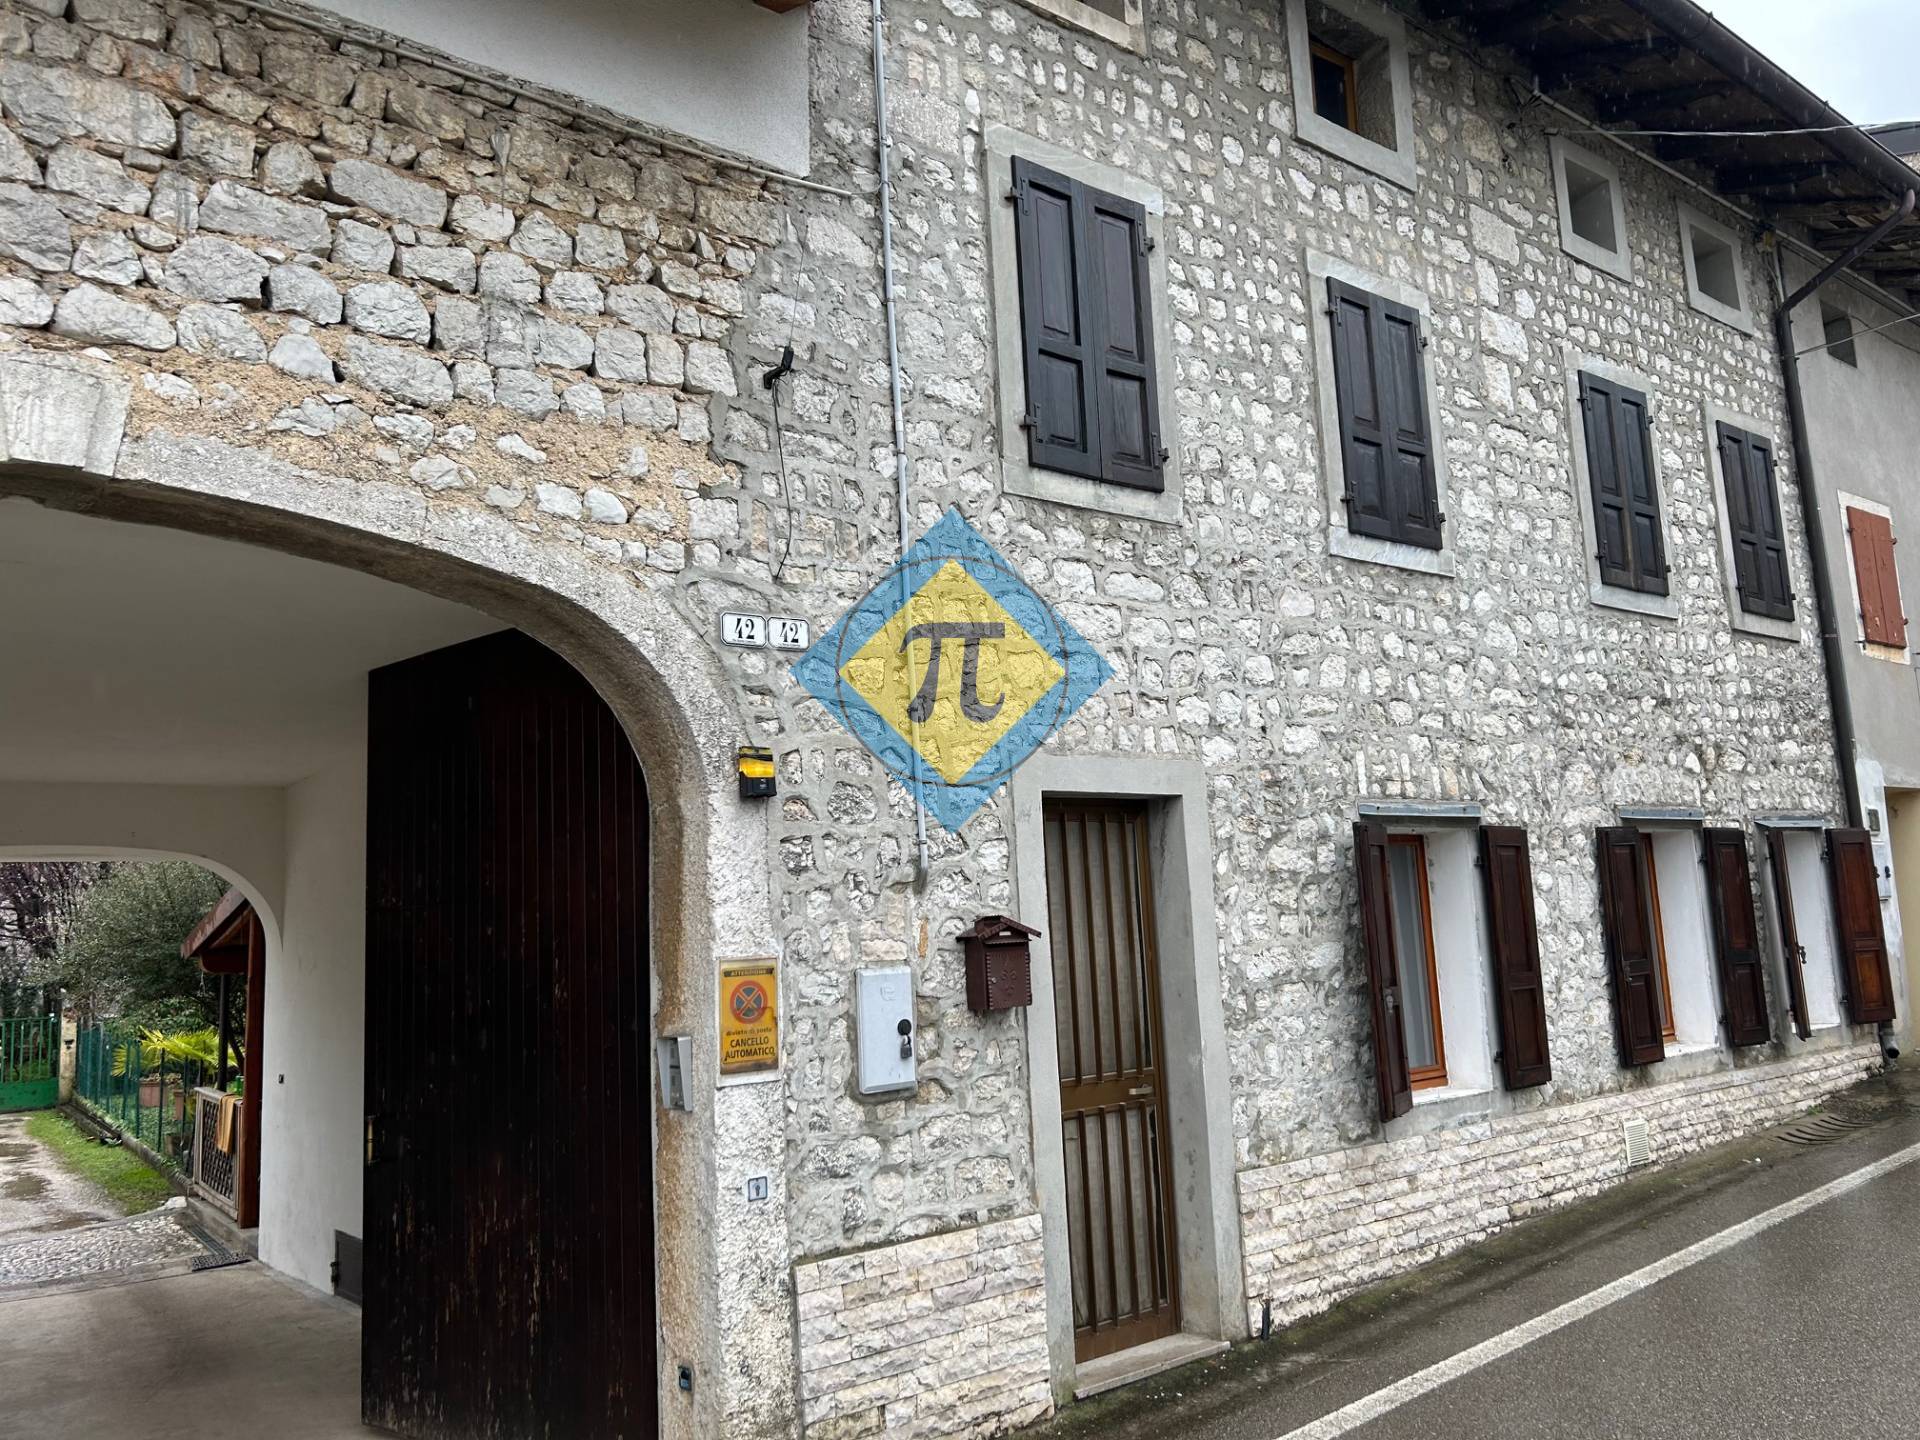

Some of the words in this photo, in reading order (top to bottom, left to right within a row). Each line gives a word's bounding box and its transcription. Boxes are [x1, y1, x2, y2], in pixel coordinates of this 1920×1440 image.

[734, 618, 755, 640] 42
[730, 1036, 769, 1048] CANCELLO
[725, 1046, 774, 1058] AUTOMATICO
